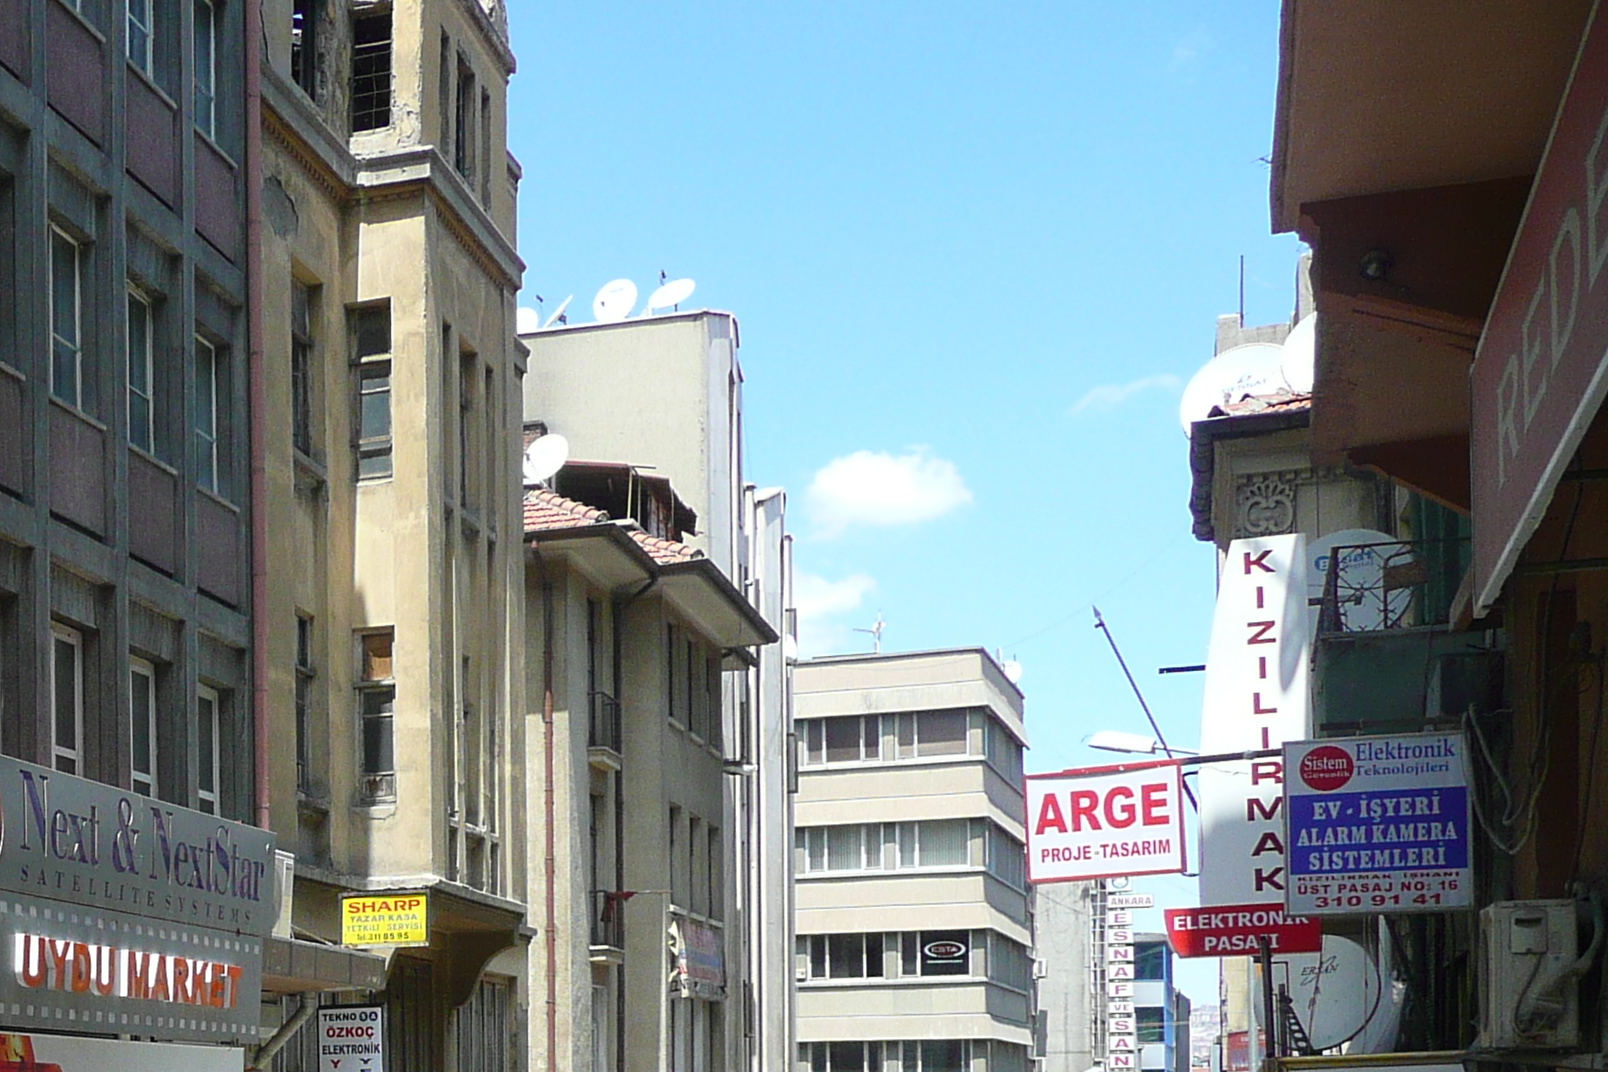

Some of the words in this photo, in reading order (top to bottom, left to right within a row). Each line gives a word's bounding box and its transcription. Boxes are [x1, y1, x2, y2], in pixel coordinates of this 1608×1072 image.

[1243, 549, 1284, 892] KIZILIRMAK
[1355, 738, 1455, 761] Elektronik
[1304, 756, 1347, 771] Sistem
[1355, 761, 1450, 776] Teknolojileri
[1035, 782, 1170, 836] ARGE
[1312, 801, 1341, 820] EV
[1359, 790, 1441, 823] İŞYERİ
[19, 768, 100, 869] Next
[111, 797, 140, 875] &
[148, 806, 265, 902] NextStar
[1296, 825, 1367, 847] ALARM
[1372, 820, 1458, 843] KAMERA
[1309, 842, 1446, 871] SİSTEMLERİ
[20, 864, 156, 907] SATELLITE
[164, 895, 252, 923] SYSTEMS
[1298, 882, 1332, 896] ÜST
[1337, 881, 1394, 895] PASAJ
[1438, 879, 1459, 891] 16
[348, 899, 421, 914] SHARP
[1110, 896, 1153, 905] ANKARA
[1314, 896, 1362, 908] 310
[1370, 894, 1401, 906] 91
[1412, 893, 1442, 905] 41
[350, 914, 385, 924] YAZAR
[388, 914, 418, 922] KASA
[1113, 912, 1129, 995] ESNAF
[15, 932, 116, 997] UYDU
[128, 948, 244, 1008] MARKET
[1114, 1003, 1131, 1012] VE
[322, 1013, 357, 1022] TEKNO
[326, 1025, 375, 1040] ÖZKOÇ
[322, 1041, 380, 1056] ELEKTRONİK
